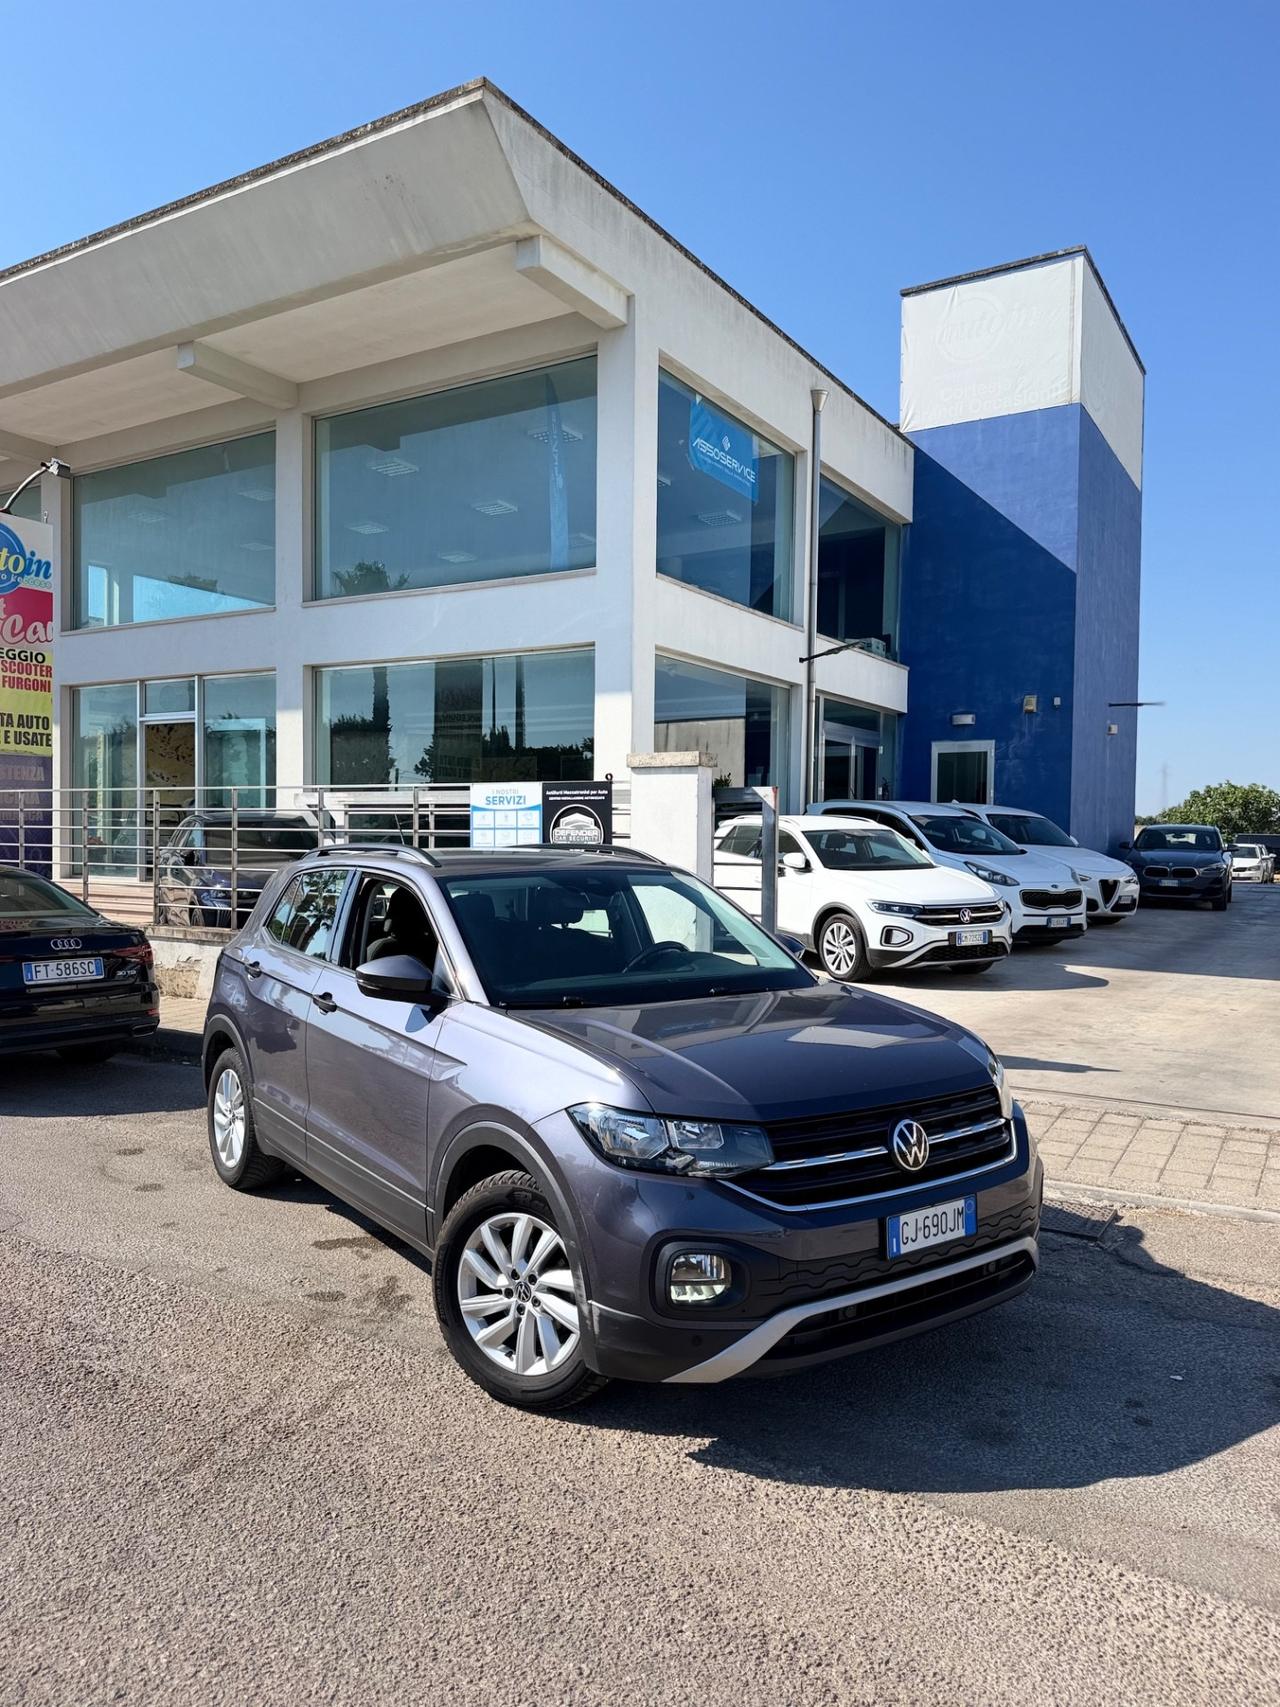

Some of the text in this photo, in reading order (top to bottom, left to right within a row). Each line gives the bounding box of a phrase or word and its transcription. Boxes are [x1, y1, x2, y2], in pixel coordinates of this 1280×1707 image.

[1, 660, 53, 678] SCOOTER
[2, 675, 52, 693] FURGONI
[17, 714, 50, 731] AUTO
[13, 731, 52, 747] USATE
[485, 795, 527, 806] SERVIZI
